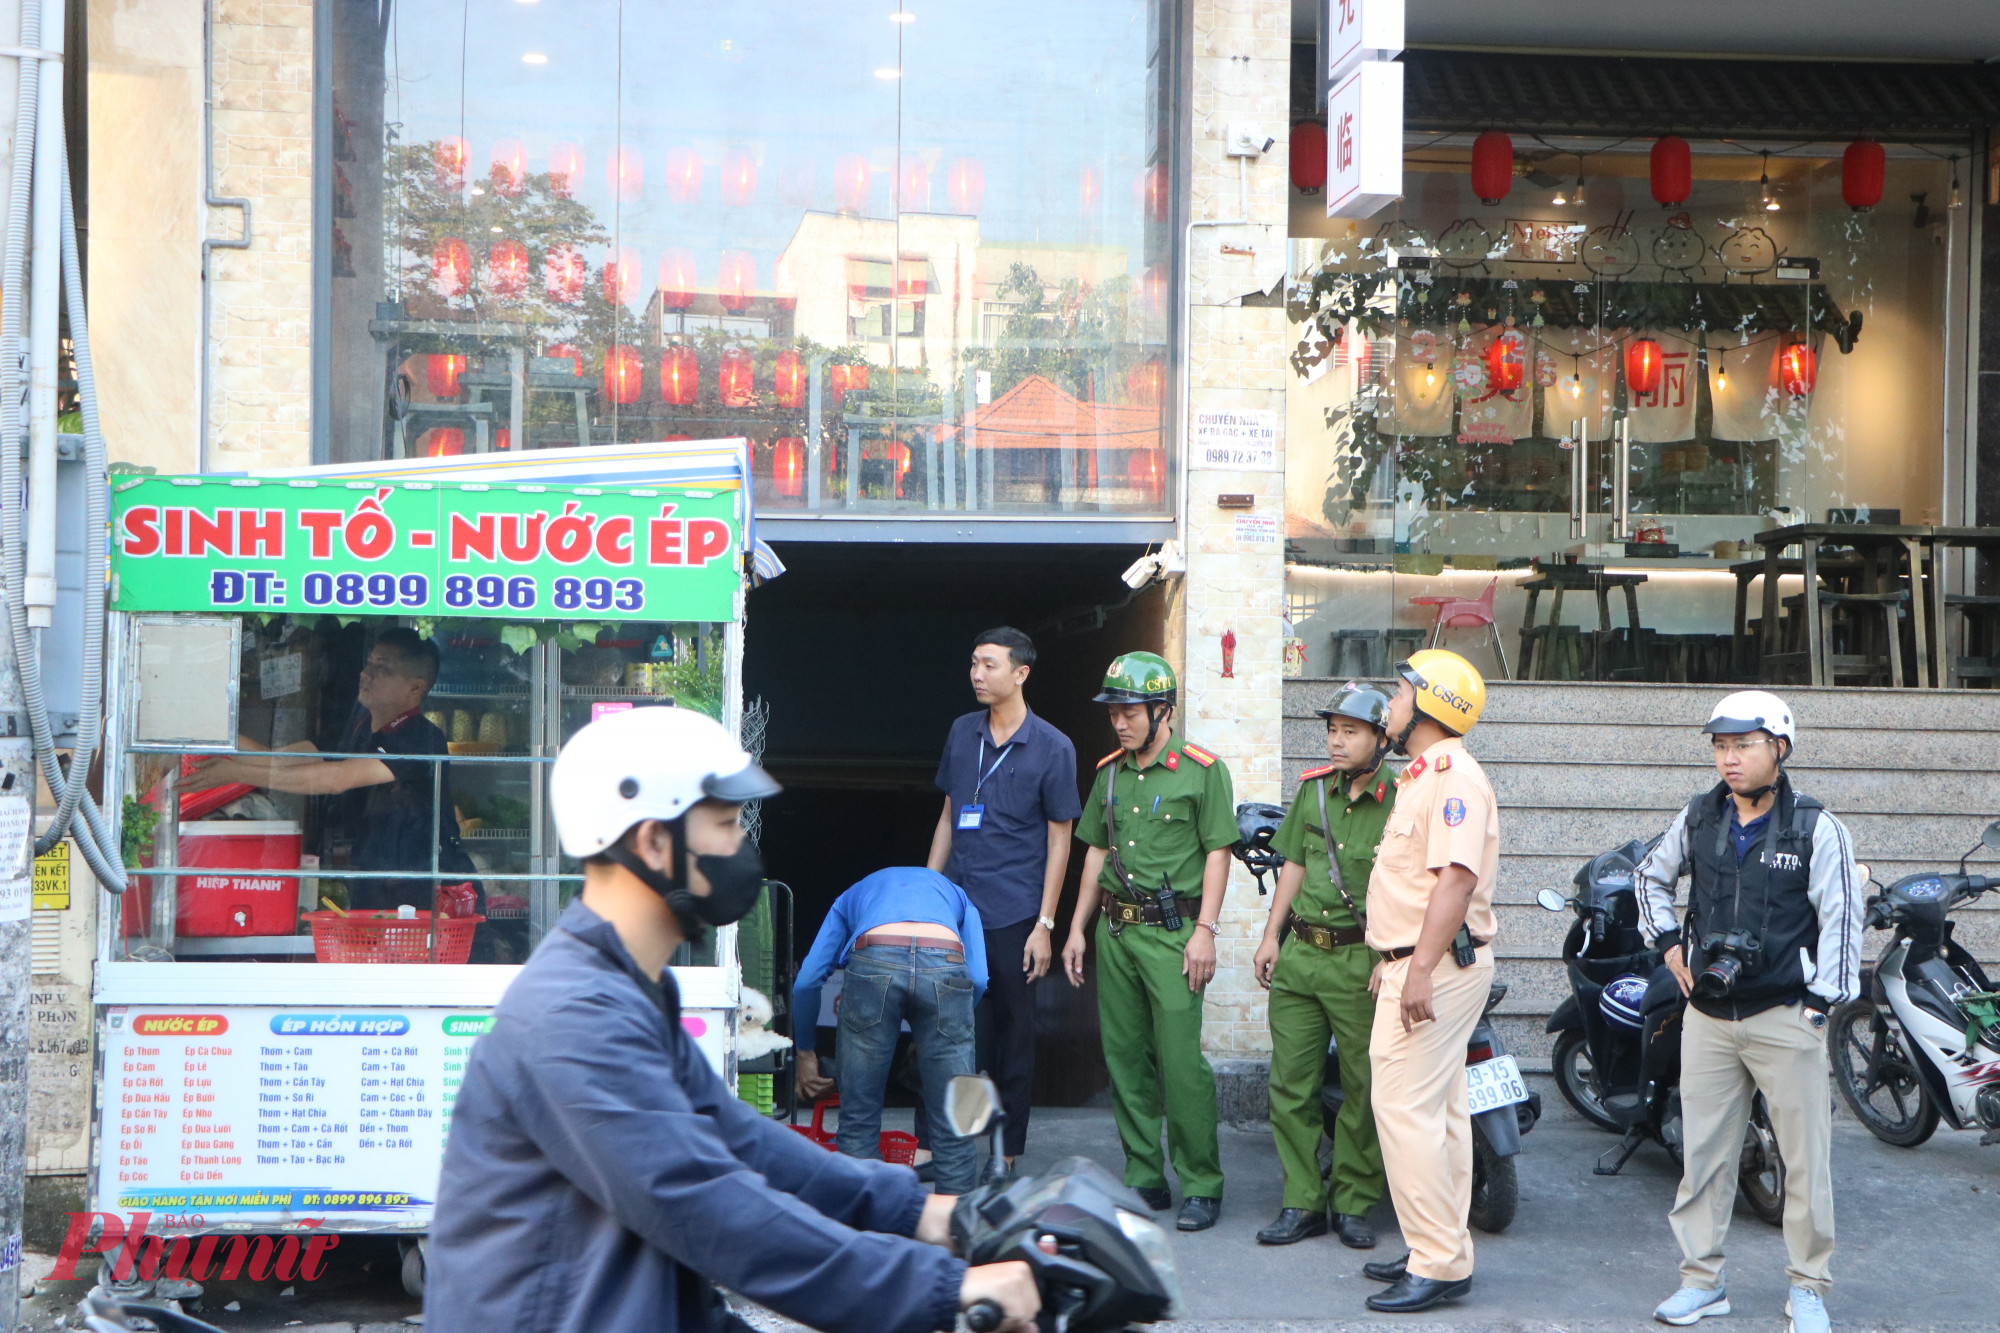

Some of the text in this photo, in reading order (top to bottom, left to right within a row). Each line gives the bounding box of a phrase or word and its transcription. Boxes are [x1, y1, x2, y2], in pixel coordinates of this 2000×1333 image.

[1206, 448, 1229, 463] 0989
[1232, 449, 1244, 463] 72
[122, 506, 284, 559] SINH
[297, 488, 396, 561] TỐ
[449, 501, 635, 565] NƯỚC
[647, 502, 731, 568] ÉP
[210, 570, 645, 612] ĐT: 0899 896 893
[1432, 684, 1473, 715] CSGT
[35, 863, 47, 877] ÊN
[143, 1016, 218, 1031] NƯỚC ÉP
[281, 1017, 307, 1033] ÉP
[360, 1018, 403, 1036] HỢP
[450, 1021, 484, 1033] SINH
[124, 1046, 134, 1056] Ép
[185, 1046, 195, 1056] Ép
[211, 1046, 232, 1055] Chua
[294, 1047, 312, 1055] Cam
[362, 1046, 380, 1055] Cam
[123, 1062, 155, 1072] Ép Cam
[184, 1061, 195, 1071] Ép
[362, 1063, 380, 1071] Cam
[444, 1063, 461, 1071] Sinh
[1466, 1061, 1509, 1088] 29-X5
[123, 1077, 133, 1087] Ép
[184, 1077, 194, 1087] Ép
[362, 1078, 424, 1088] Cam Hạt Chia
[122, 1092, 132, 1103] Ép
[184, 1093, 193, 1103] Ép
[306, 1093, 314, 1102] Ri
[361, 1093, 379, 1102] Cam
[121, 1109, 132, 1119] Ép
[183, 1108, 212, 1118] Ép Nho
[292, 1109, 305, 1119] Hạt
[308, 1109, 326, 1117] Chia
[360, 1109, 378, 1117] Cam
[390, 1109, 415, 1117] Chanh
[121, 1125, 131, 1134] Ép
[148, 1125, 156, 1133] Ri
[182, 1124, 192, 1134] Ép
[292, 1124, 310, 1133] Cam
[121, 1139, 130, 1150] Ép
[182, 1139, 192, 1149] Ép
[213, 1139, 234, 1149] Gang
[120, 1156, 130, 1166] Ép
[181, 1155, 241, 1165] Ép Thanh Long
[317, 1155, 332, 1166] Bạc
[119, 1172, 129, 1181] Ép
[181, 1171, 190, 1181] Ép
[118, 1195, 149, 1208] GIAO
[151, 1193, 187, 1207] HÀNG
[189, 1194, 213, 1209] TẬN
[214, 1193, 239, 1207] NƠI
[239, 1190, 271, 1206] MIỄN
[271, 1192, 293, 1206] PHÍ
[323, 1193, 356, 1206] 0899
[357, 1193, 382, 1206] 896
[384, 1193, 409, 1206] 893
